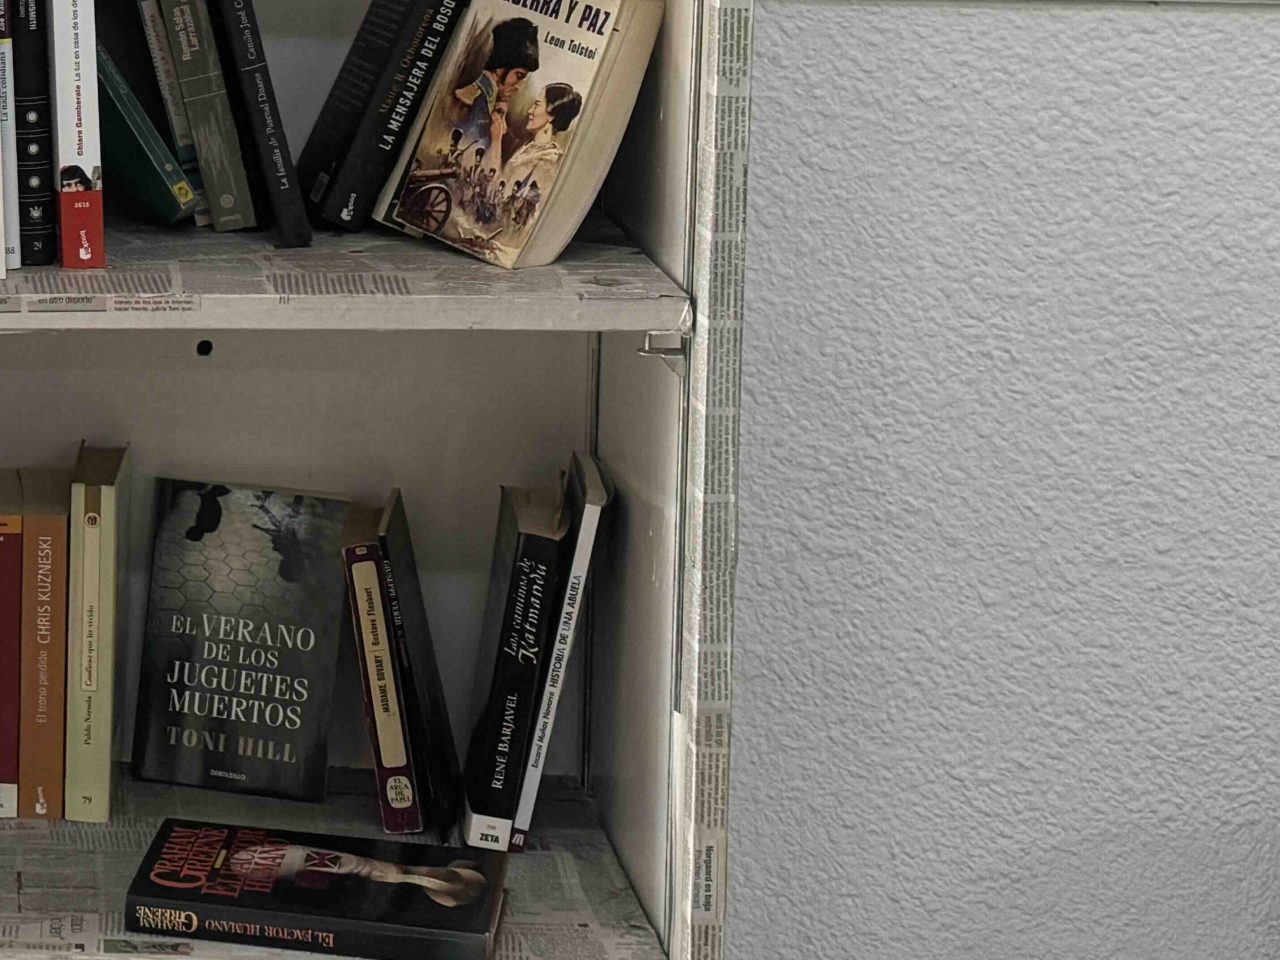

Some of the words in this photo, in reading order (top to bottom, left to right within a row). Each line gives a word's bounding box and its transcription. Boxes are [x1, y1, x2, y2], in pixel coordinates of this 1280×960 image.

[577, 4, 612, 36] PAZ
[567, 38, 598, 61] Tolstoi
[0, 51, 7, 90] cotidiana
[0, 91, 8, 111] nada
[378, 133, 392, 151] LA
[387, 59, 429, 131] MENSAJERA
[420, 32, 441, 59] DEL
[1, 112, 9, 122] La
[272, 147, 287, 176] familia
[38, 535, 53, 602] KUZNESKI
[522, 557, 532, 575] de
[565, 573, 583, 610] ABUELA
[37, 604, 51, 644] CHRIS
[518, 561, 548, 665] Katmandú
[560, 610, 576, 632] UNA
[85, 640, 95, 654] que
[170, 614, 197, 636] EL
[200, 613, 317, 653] VERANO
[557, 631, 570, 646] DE
[38, 650, 49, 686] perdido
[202, 640, 231, 662] DE
[237, 646, 280, 670] LOS
[375, 653, 385, 683] BOVARY
[548, 646, 567, 689] HISTORIA
[166, 660, 310, 704] JUGUETES
[37, 687, 48, 713] trono
[83, 695, 93, 723] Neruda
[167, 688, 303, 731] MUERTOS
[380, 682, 391, 714] MADAME
[37, 714, 47, 723] El
[496, 691, 519, 754] BARJAVEL
[83, 723, 93, 746] Pablo
[165, 725, 227, 753] TONI
[237, 735, 298, 764] HILL
[479, 833, 500, 845] ZETA
[150, 826, 202, 888] GRAHAM
[170, 826, 229, 888] GREENE
[204, 919, 261, 937] HUMANO
[264, 924, 316, 945] FACTOR
[317, 931, 335, 948] EL
